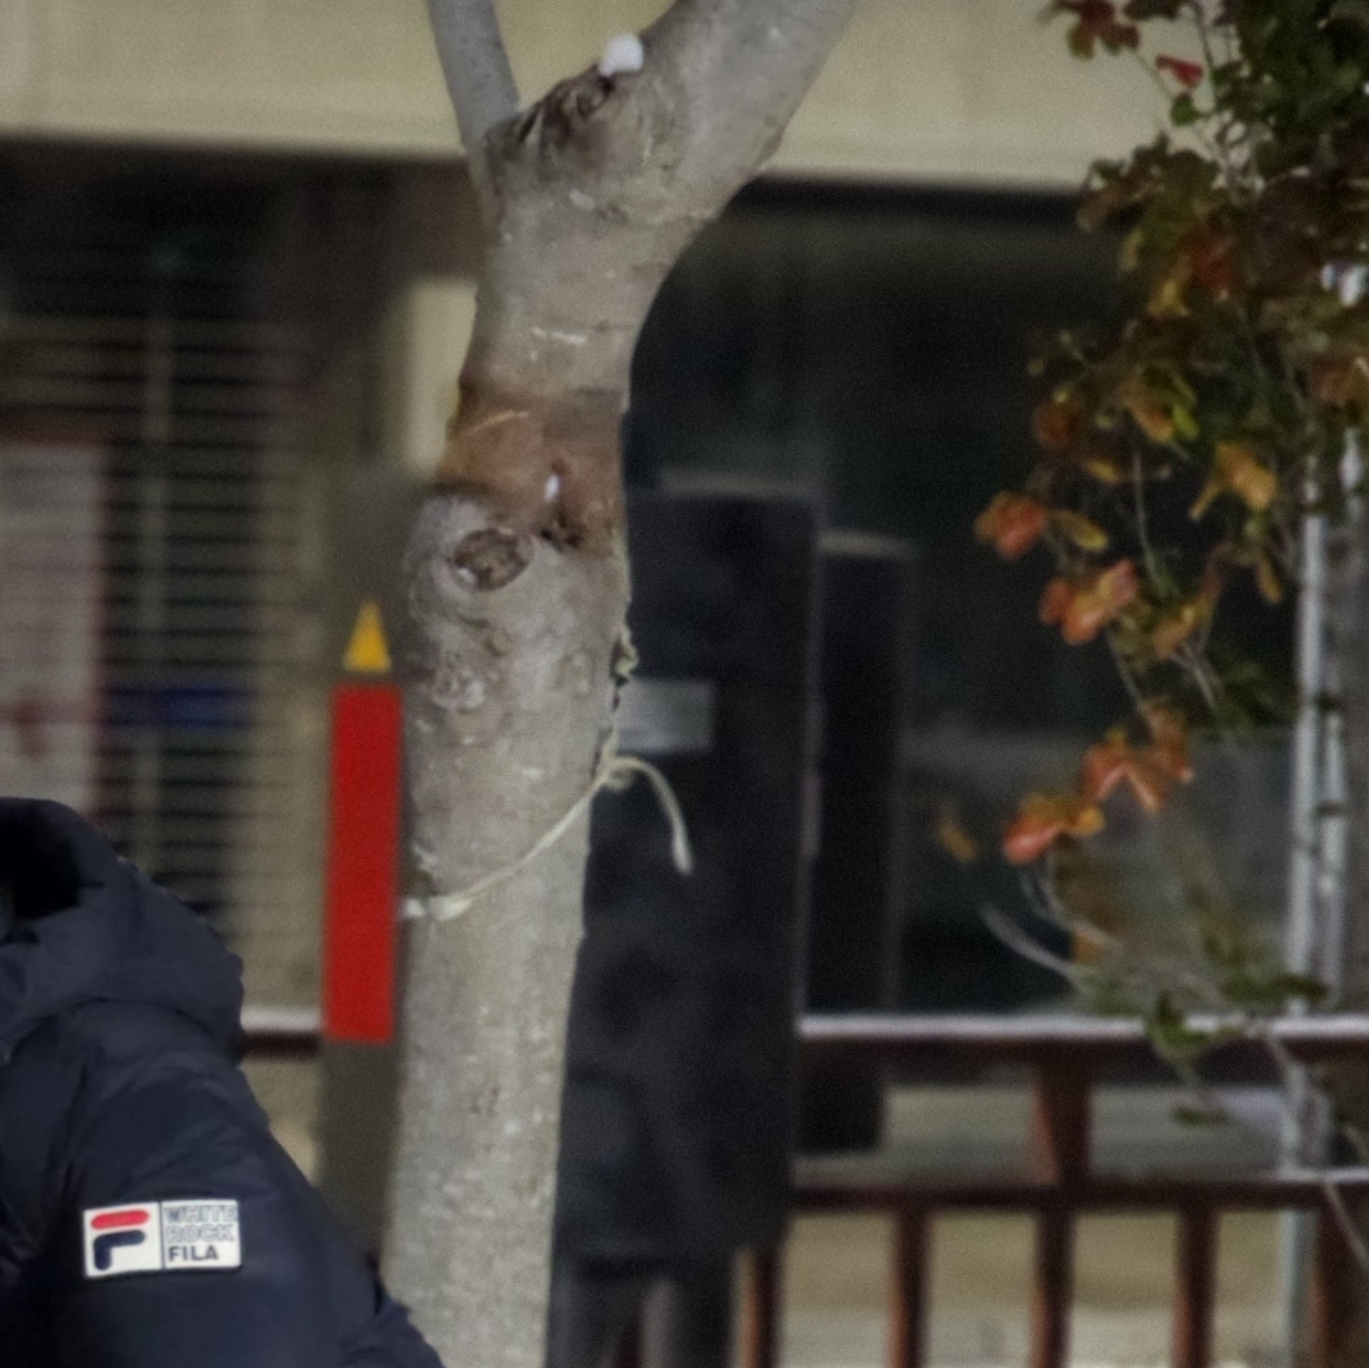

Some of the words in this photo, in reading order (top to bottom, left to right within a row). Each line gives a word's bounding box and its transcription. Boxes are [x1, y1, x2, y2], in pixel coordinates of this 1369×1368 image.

[165, 1205, 237, 1223] WHITE
[166, 1223, 235, 1243] ROCK
[168, 1245, 219, 1262] FILA
